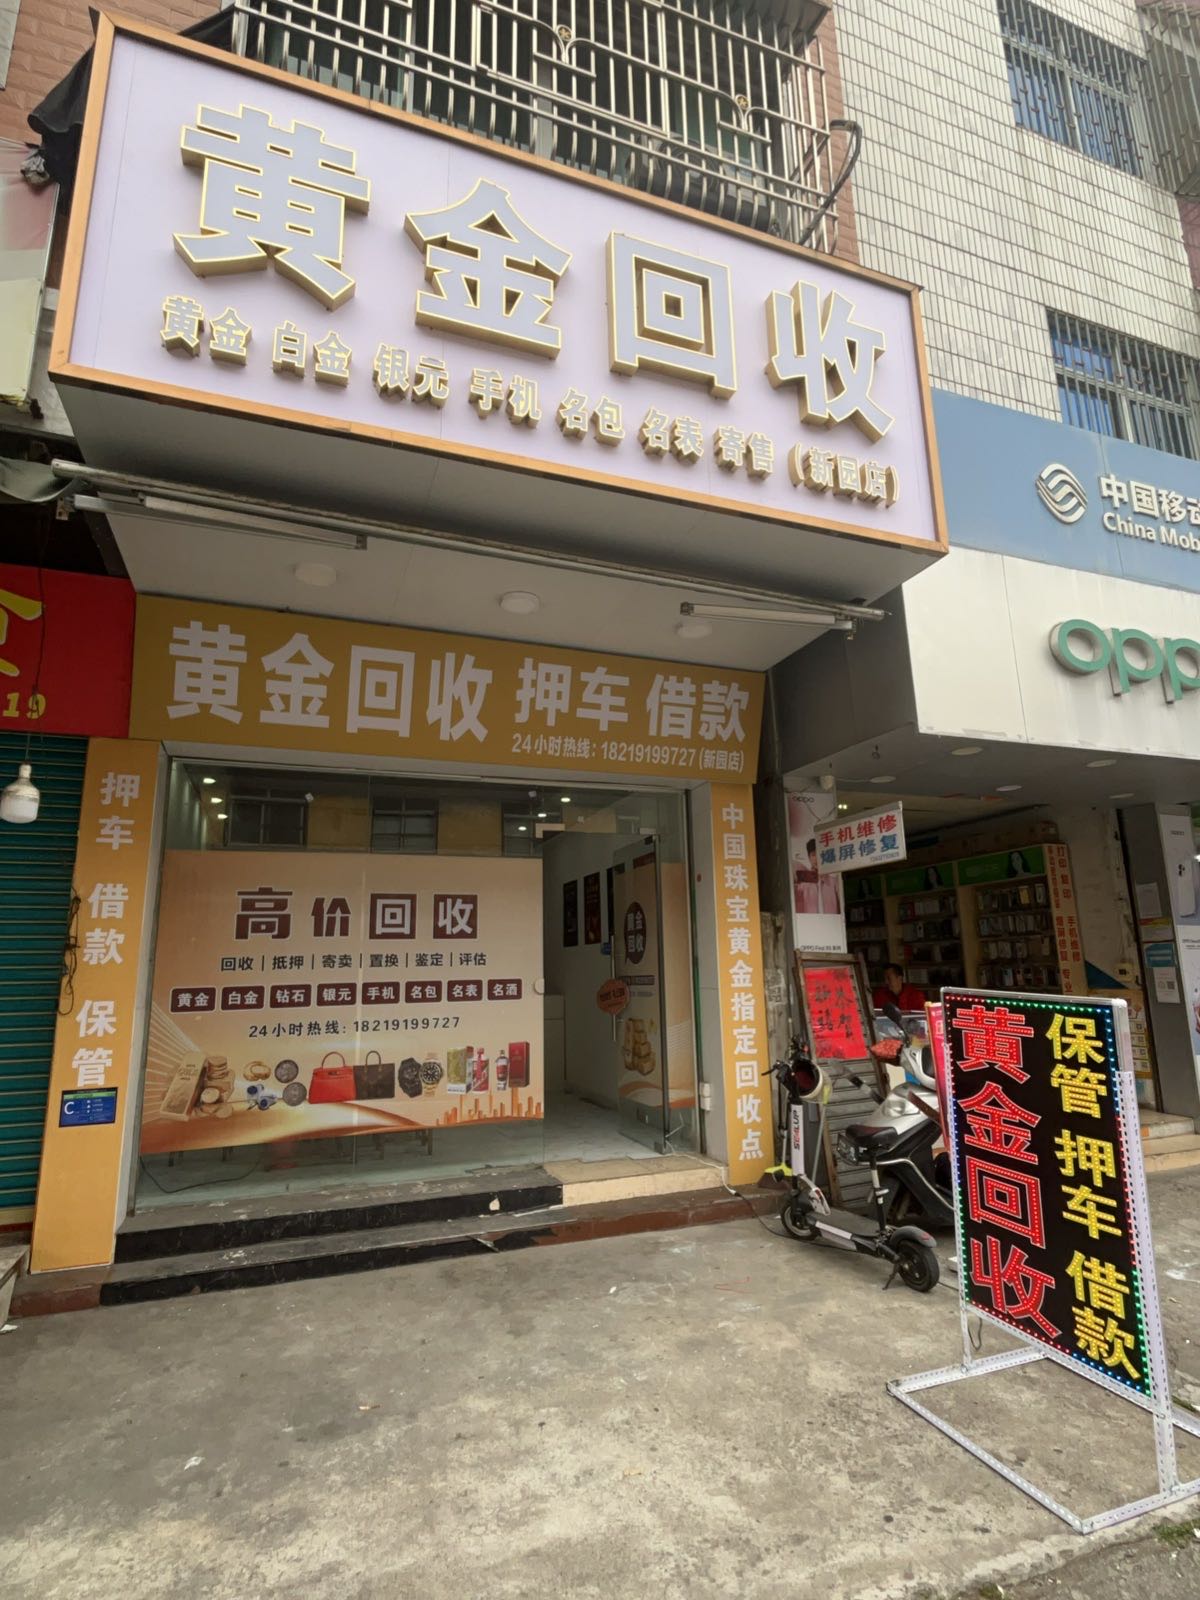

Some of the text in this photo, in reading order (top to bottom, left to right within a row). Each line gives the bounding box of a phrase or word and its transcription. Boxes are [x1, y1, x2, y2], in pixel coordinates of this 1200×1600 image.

[173, 103, 895, 442] 黄金回收
[160, 295, 252, 362] 黄金
[272, 320, 353, 384] 白金
[374, 344, 449, 407] 银元
[470, 369, 542, 425] 手机
[557, 388, 625, 444] 名包
[640, 408, 703, 462] 名表
[713, 426, 775, 477] 寄售
[1102, 511, 1156, 542] China
[167, 621, 749, 744] 黄金回收 押车 借款
[819, 814, 897, 847] 手机维修
[820, 834, 900, 865] 爆屏修复
[71, 772, 140, 1088] 押车 借款 保管
[234, 886, 478, 940] 高价回收
[177, 983, 518, 1008] 黄金 白金 钻石 银元 手机 名包 名表 名酒
[221, 952, 487, 971] 回收 抵押 寄卖 置换 鉴定 评估
[721, 803, 763, 1160] 中国珠宝黄金指定回收点
[353, 1016, 460, 1033] 18219199727
[952, 1005, 1061, 1340] 黄金回收
[1045, 1013, 1141, 1381] 保管 押车 借款
